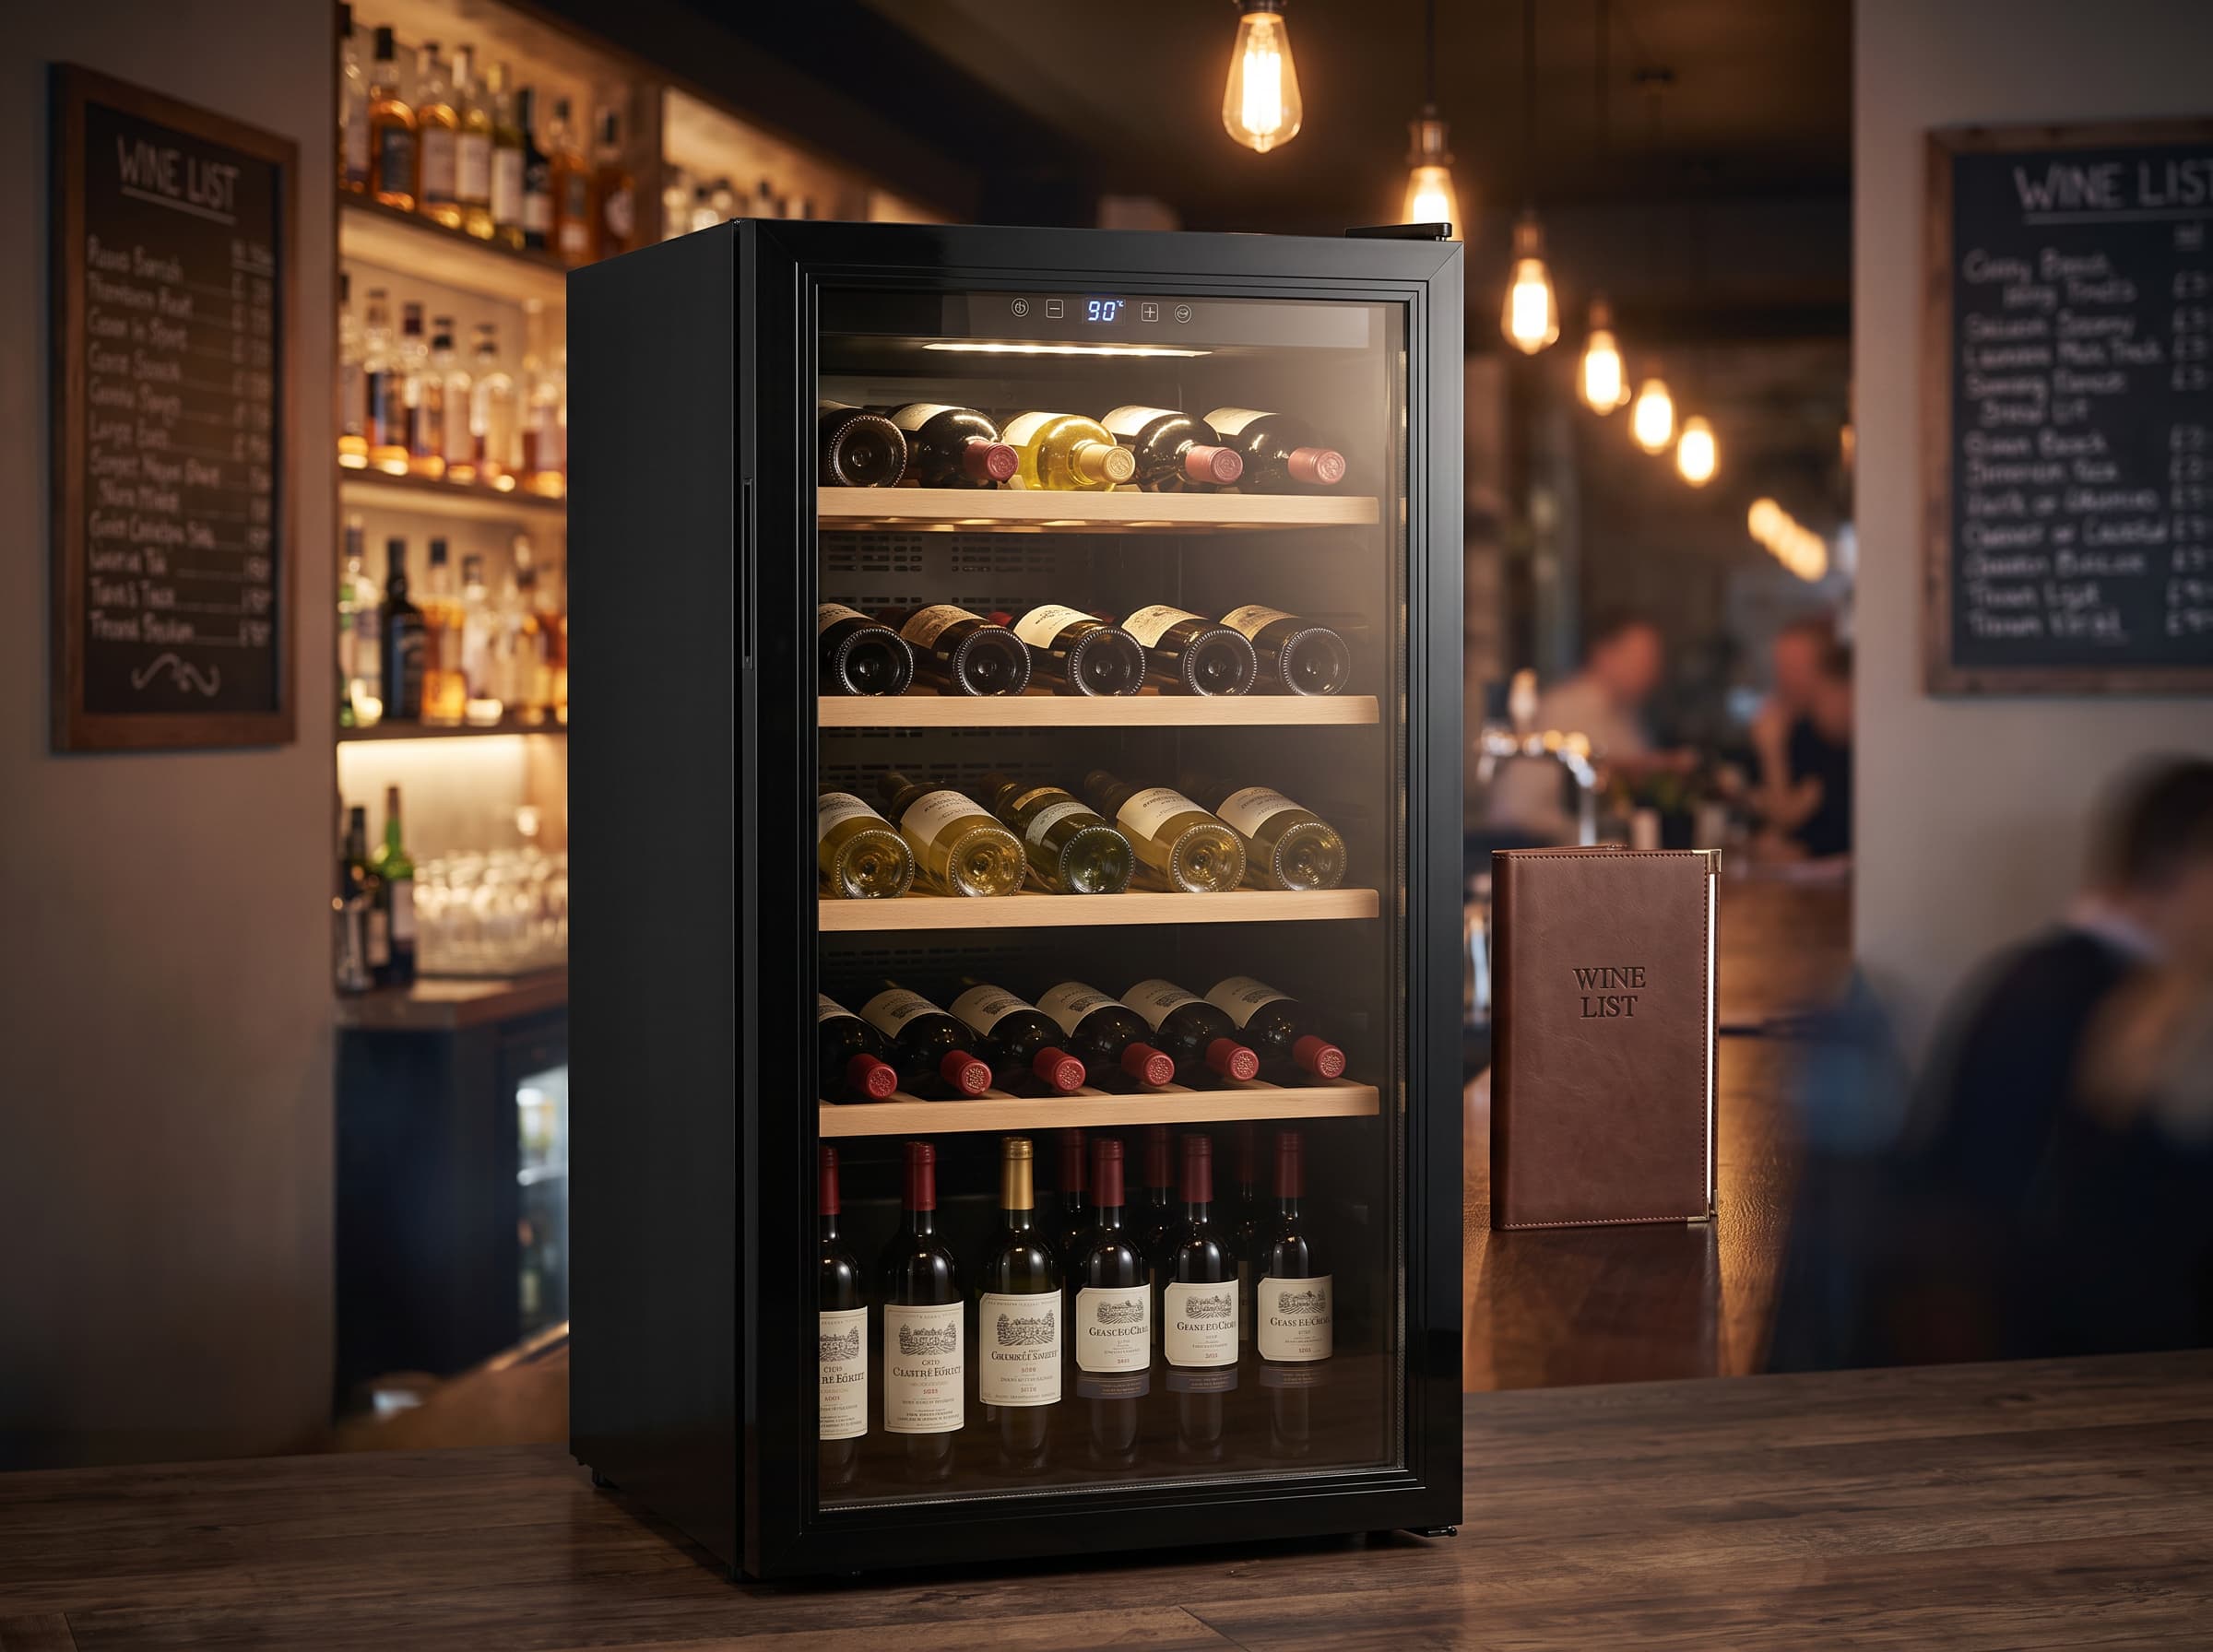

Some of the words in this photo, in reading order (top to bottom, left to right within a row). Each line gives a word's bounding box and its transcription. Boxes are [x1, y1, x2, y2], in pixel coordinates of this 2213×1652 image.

[116, 135, 182, 197] WINE
[187, 156, 241, 213] LIST
[2013, 161, 2124, 210] WINE
[1572, 966, 1647, 990] WINE
[1580, 995, 1639, 1019] LIST
